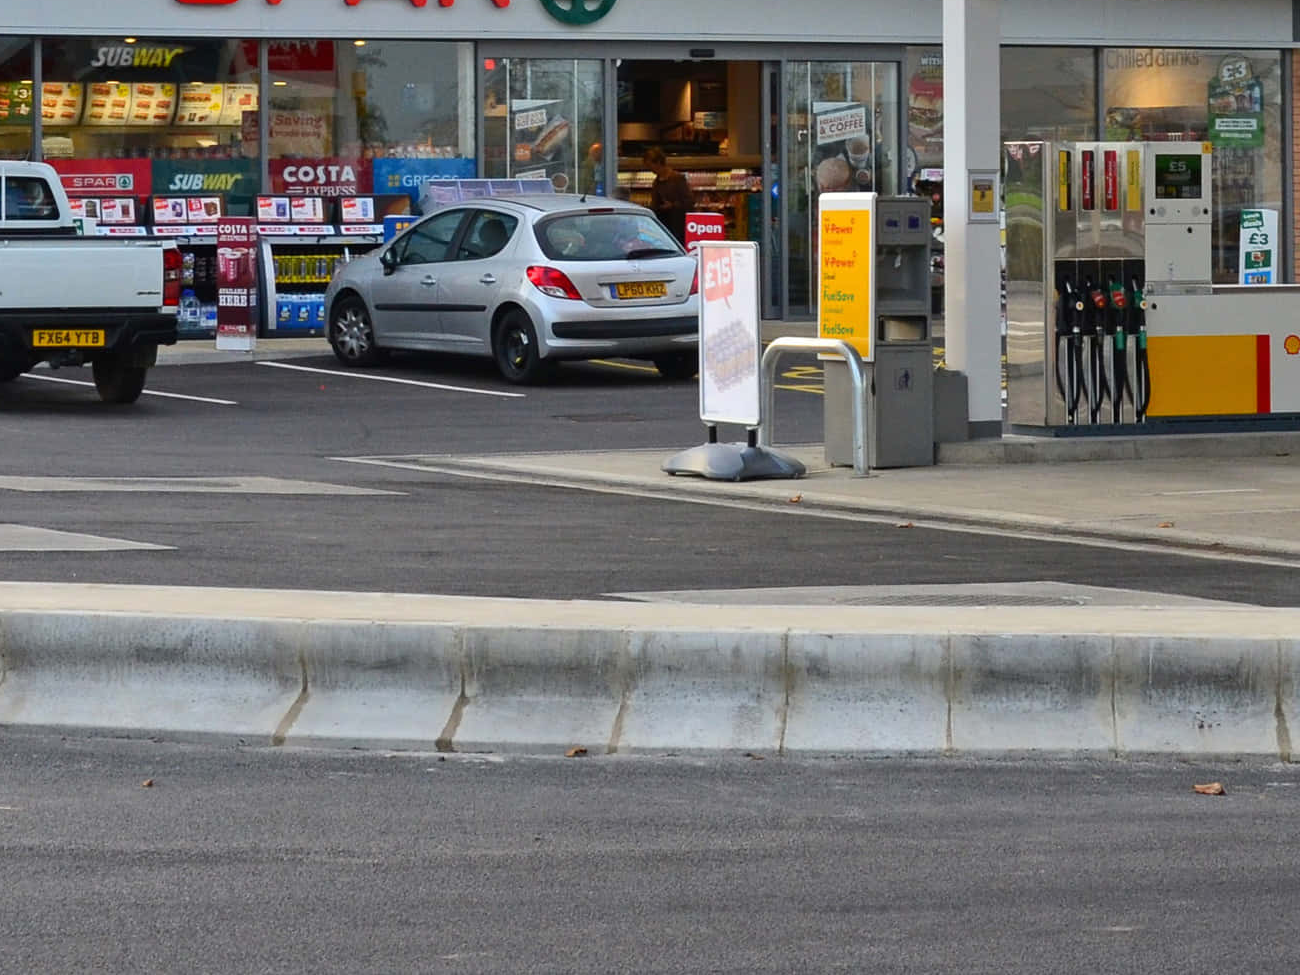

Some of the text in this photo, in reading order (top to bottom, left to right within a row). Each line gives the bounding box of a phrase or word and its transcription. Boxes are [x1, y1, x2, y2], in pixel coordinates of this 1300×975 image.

[91, 46, 184, 67] SUBWAY
[1105, 49, 1200, 69] Chilled drinks
[829, 120, 863, 133] COFFEE
[1169, 161, 1187, 172] £5
[283, 165, 356, 184] COSTA
[72, 177, 116, 188] SPAR
[169, 174, 243, 191] SUBWAY
[305, 185, 357, 195] EXPRESS
[219, 225, 248, 235] COSTA
[687, 222, 722, 235] Open
[1249, 233, 1269, 245] £3
[705, 257, 731, 289] £15
[219, 295, 247, 306] HERE
[38, 331, 100, 344] FX64 YTB
